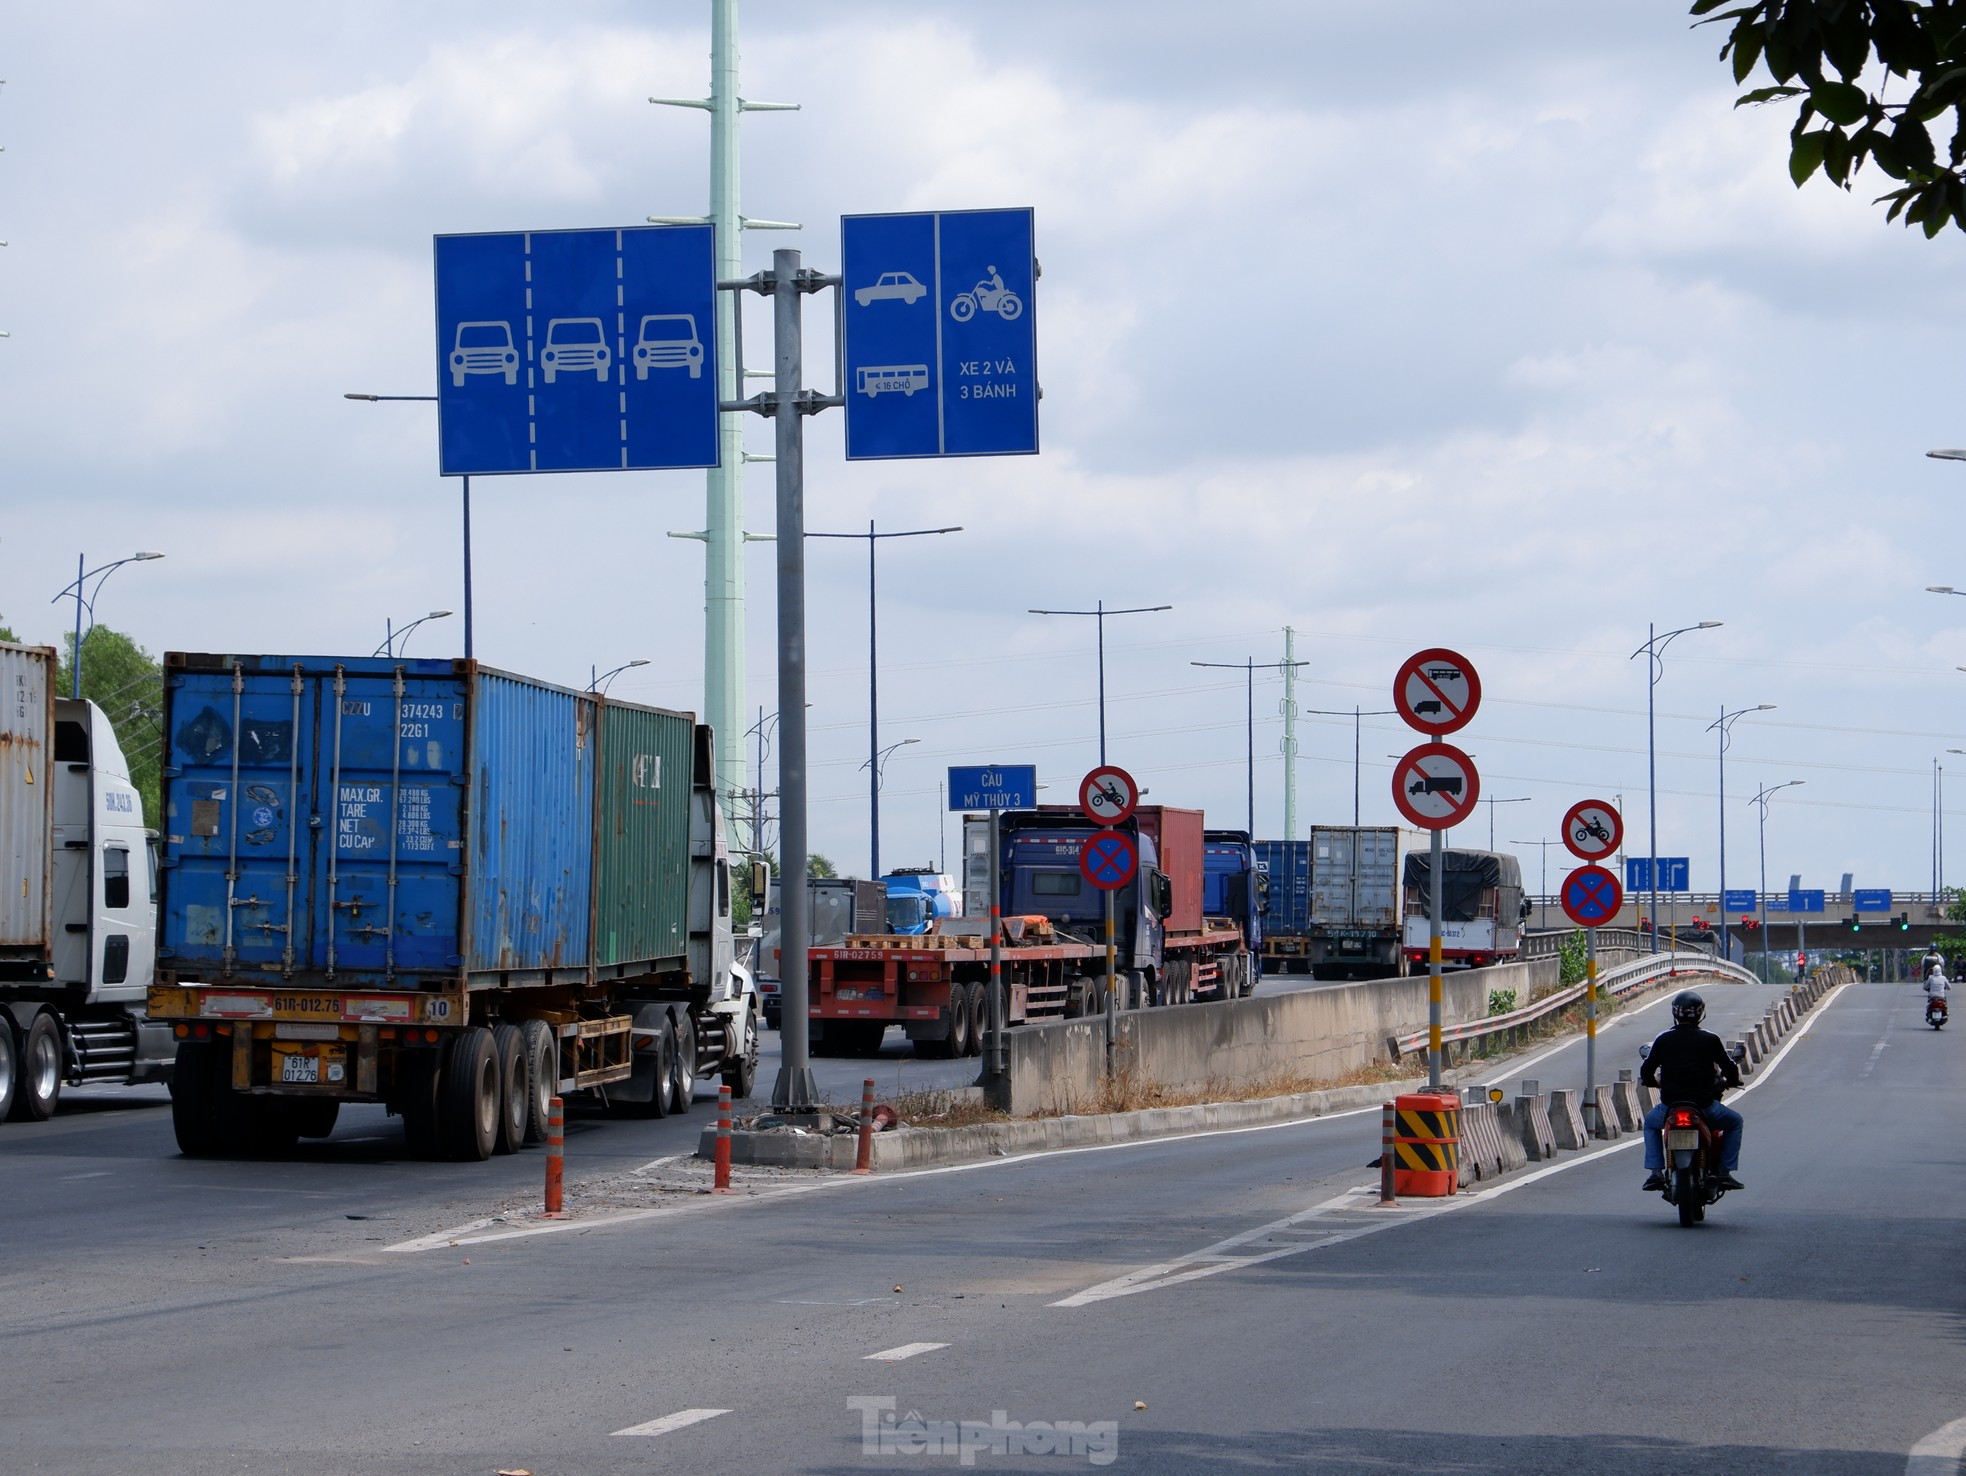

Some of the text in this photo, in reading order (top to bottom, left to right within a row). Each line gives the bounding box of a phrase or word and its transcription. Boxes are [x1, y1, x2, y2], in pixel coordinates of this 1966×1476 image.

[960, 357, 1016, 376] XE 2 VÀ
[883, 381, 892, 391] 16
[960, 381, 1016, 399] 3 BÁNH
[342, 702, 371, 716] CZZU
[401, 704, 443, 719] 374243
[400, 724, 428, 738] 22G1
[981, 769, 1003, 787] CẦU
[340, 788, 383, 803] MAX.GR.
[420, 789, 429, 797] KG
[964, 790, 1021, 807] MỸ THỦY 3
[341, 803, 367, 818] TARE
[340, 819, 360, 833] NET
[420, 820, 428, 828] KG
[834, 950, 884, 960] 61R-02759
[430, 1001, 448, 1016] 10
[291, 1057, 310, 1070] 61R
